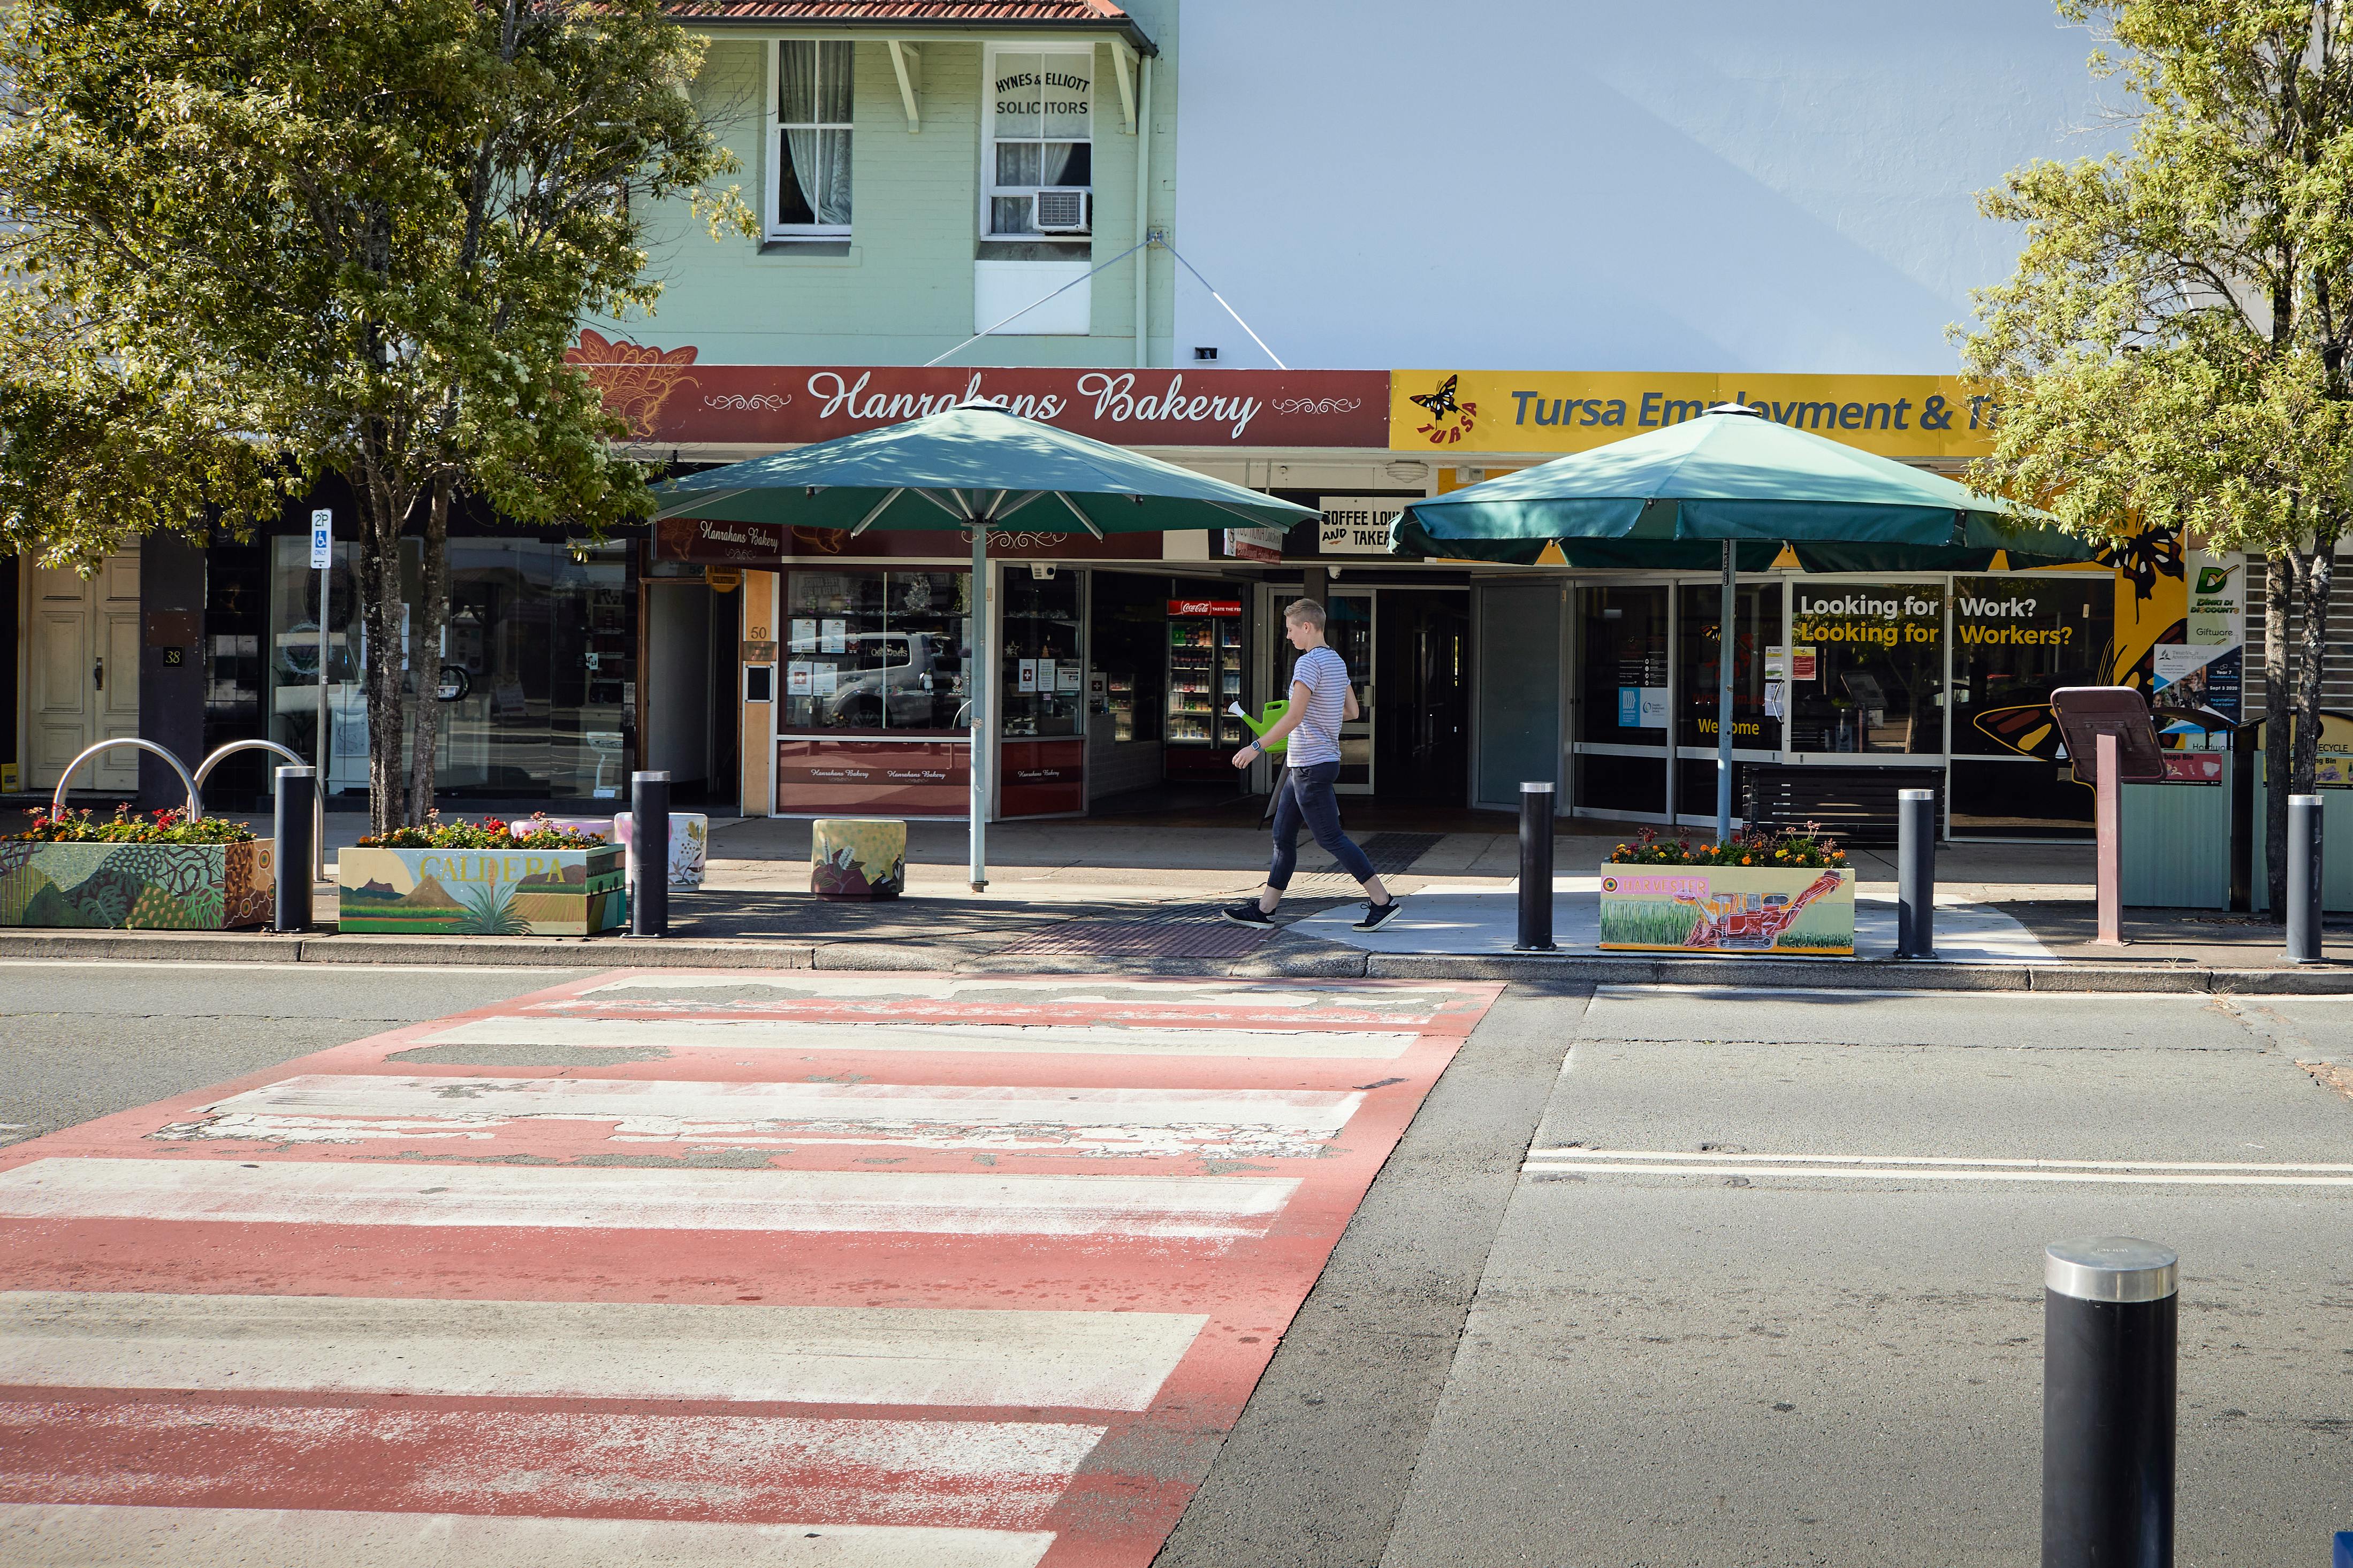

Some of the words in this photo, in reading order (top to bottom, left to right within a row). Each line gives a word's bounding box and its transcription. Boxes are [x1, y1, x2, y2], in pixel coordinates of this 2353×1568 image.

[995, 73, 1032, 93] HYNES
[1034, 75, 1041, 85] &
[1045, 73, 1090, 93] ELLIOTT
[996, 102, 1088, 114] SOLICITORS
[1077, 372, 1262, 439] Bakery
[1512, 391, 1626, 426] Tursa
[1920, 395, 1953, 431] &
[1417, 402, 1476, 444] TURSA
[315, 514, 329, 527] 2P
[700, 521, 747, 544] Hanrahans
[748, 527, 779, 553] Bakery
[1322, 527, 1347, 541] AND
[1801, 594, 1898, 619] Looking
[1904, 595, 1939, 616] for
[1959, 597, 2037, 617] Work?
[751, 626, 767, 639] 50
[1801, 621, 1898, 647] Looking
[1904, 623, 1939, 643] for
[1959, 625, 2073, 645] Workers?
[2196, 628, 2233, 636] Giftware
[166, 651, 180, 663] 38
[1698, 718, 1760, 735] Weome
[2318, 744, 2348, 752] ECYCLE
[845, 770, 870, 779] Bakery
[922, 771, 946, 779] Bakery
[420, 855, 566, 883] CALDERA
[1623, 879, 1706, 894] HARVESTER
